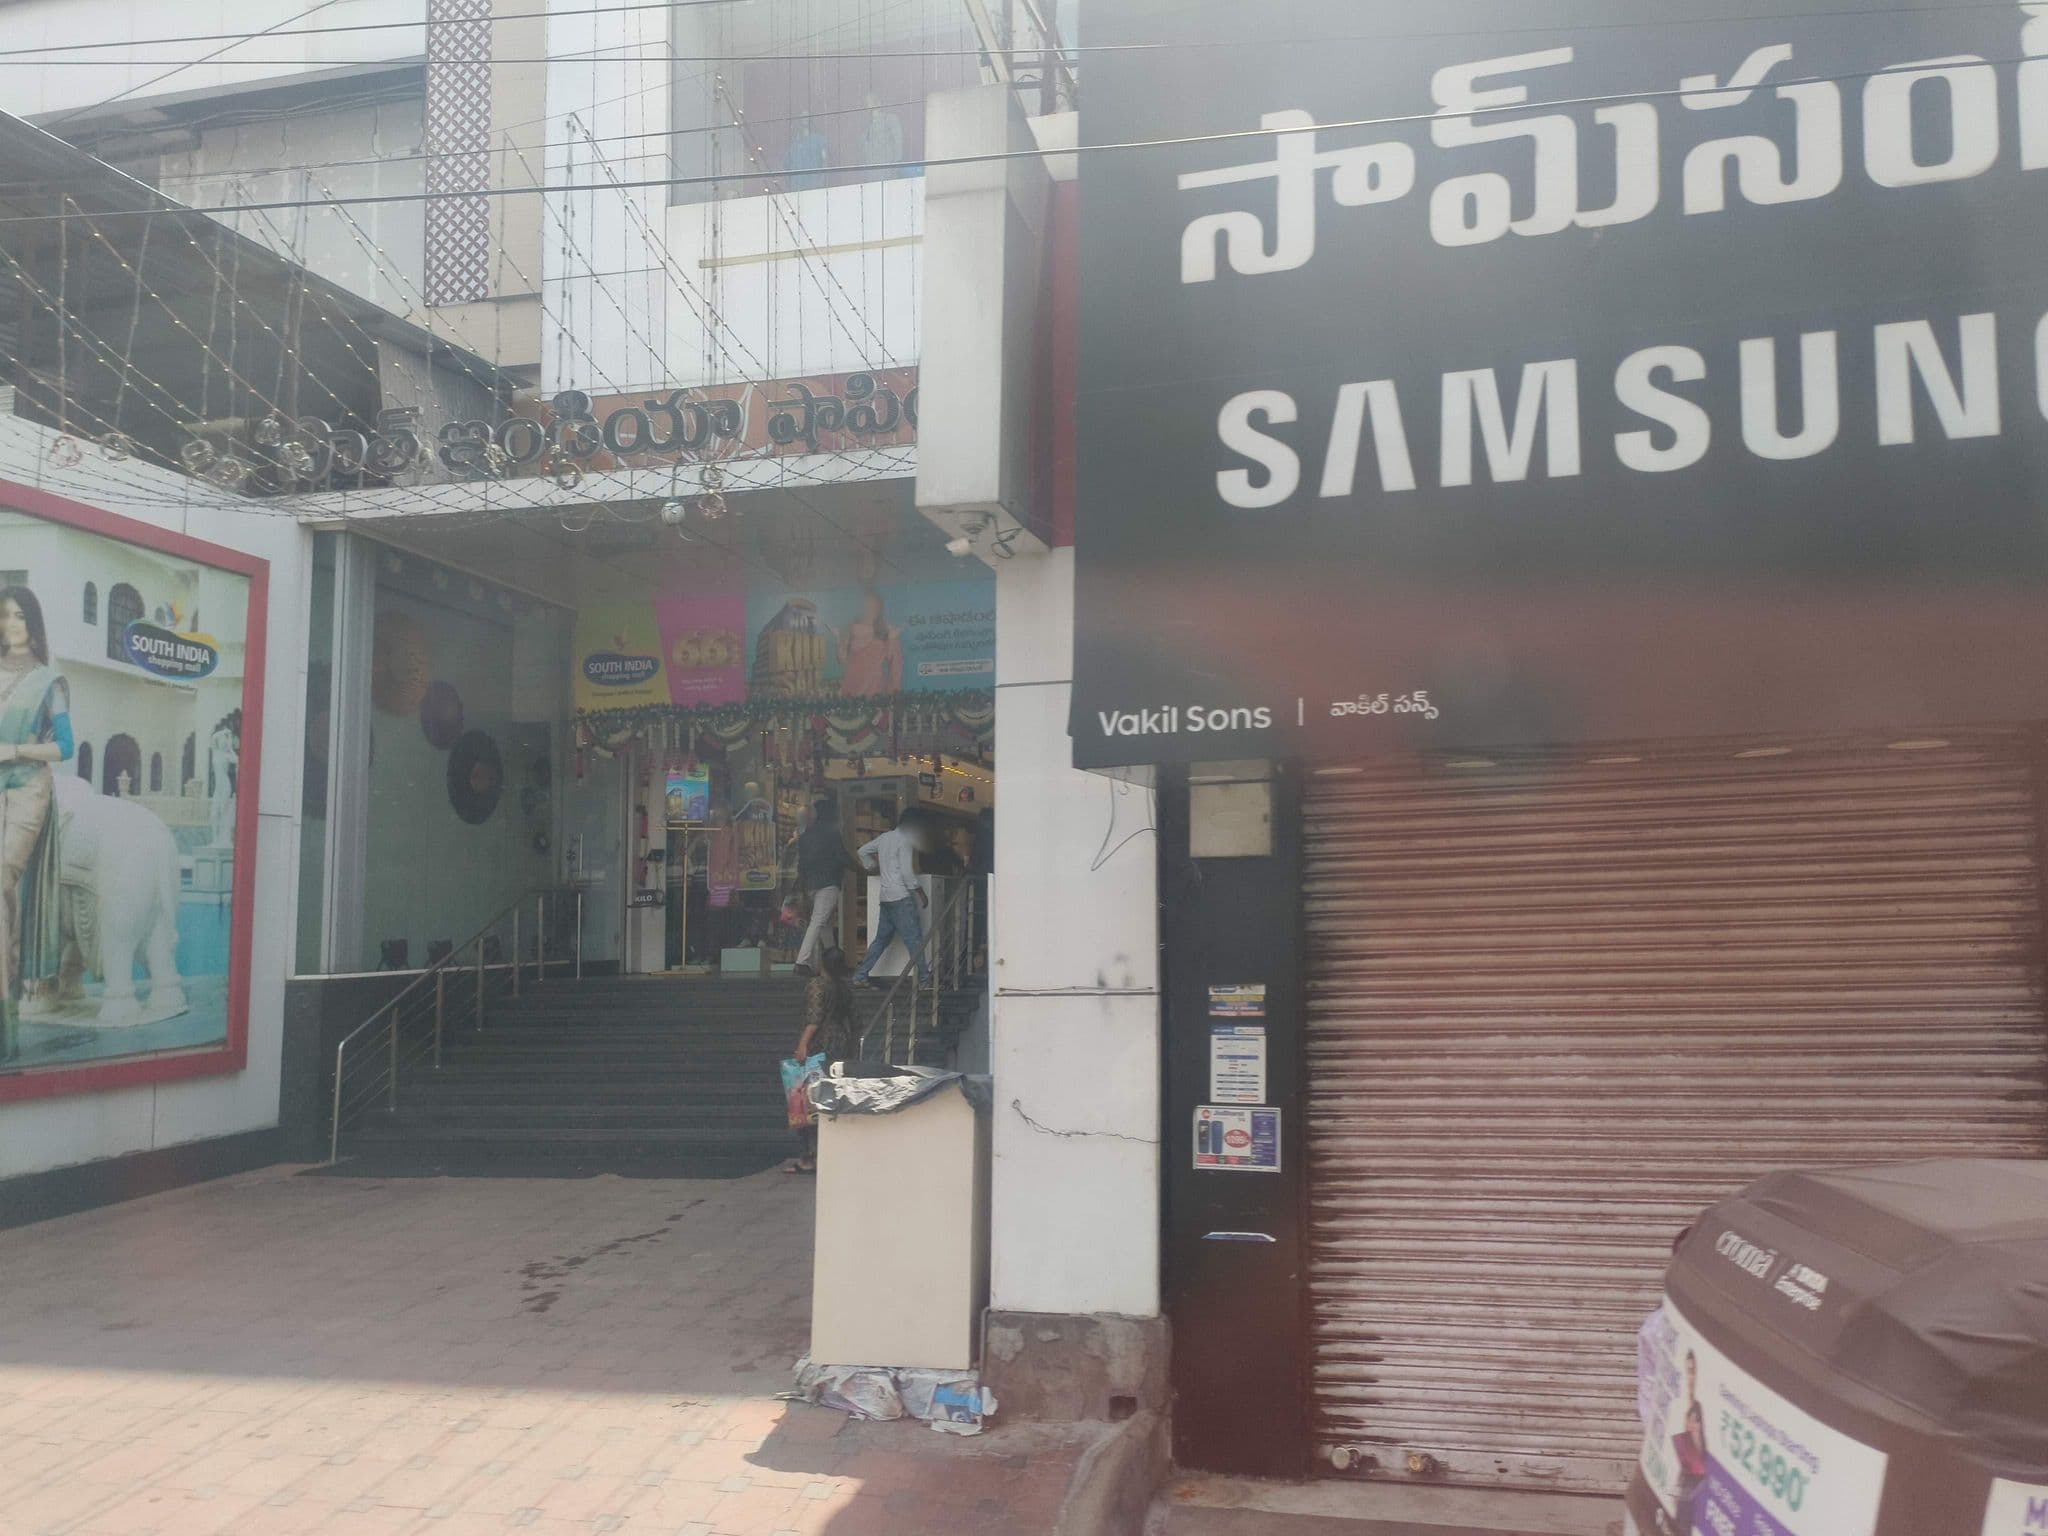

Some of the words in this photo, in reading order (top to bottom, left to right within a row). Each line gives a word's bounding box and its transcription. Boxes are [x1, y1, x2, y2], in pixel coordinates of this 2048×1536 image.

[1216, 311, 2048, 509] SAMSUN
[131, 634, 174, 658] SOUTH
[177, 643, 210, 665] INDIA
[588, 661, 622, 674] SOUTH
[624, 659, 653, 671] INDIA
[1098, 705, 1178, 737] Vakil
[1186, 705, 1272, 733] Sons
